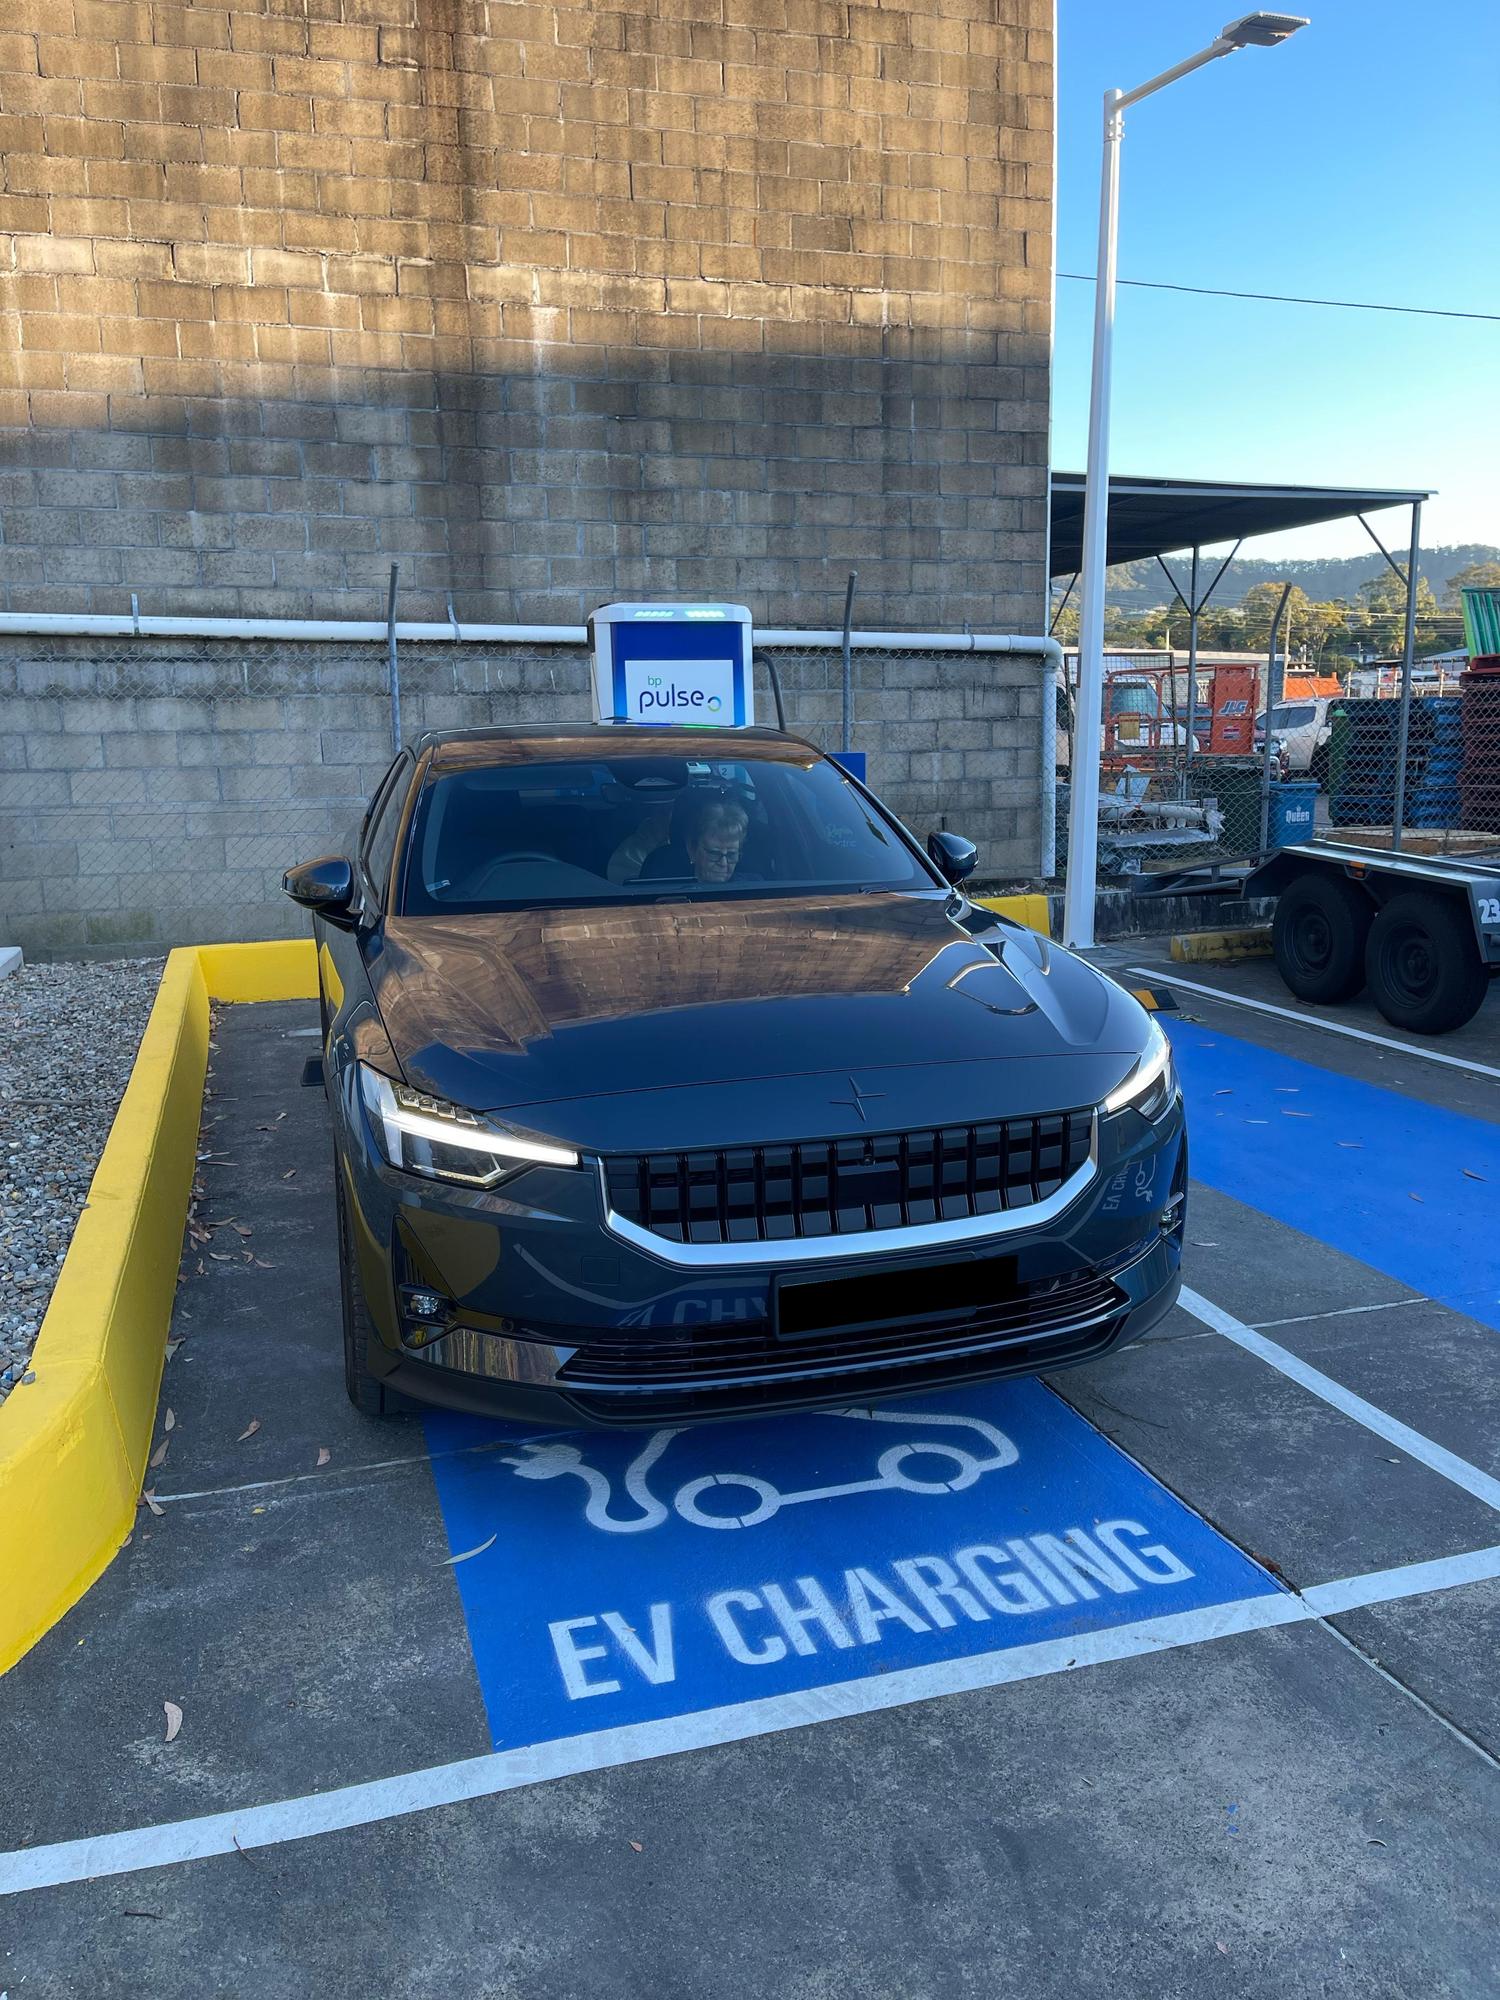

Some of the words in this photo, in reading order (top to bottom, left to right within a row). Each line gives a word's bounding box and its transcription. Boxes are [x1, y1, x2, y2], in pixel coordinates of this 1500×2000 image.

[648, 676, 661, 687] bp
[640, 684, 704, 713] pulse
[1219, 700, 1248, 714] JLG
[549, 1602, 675, 1700] EV
[706, 1519, 1195, 1665] CHARGING
